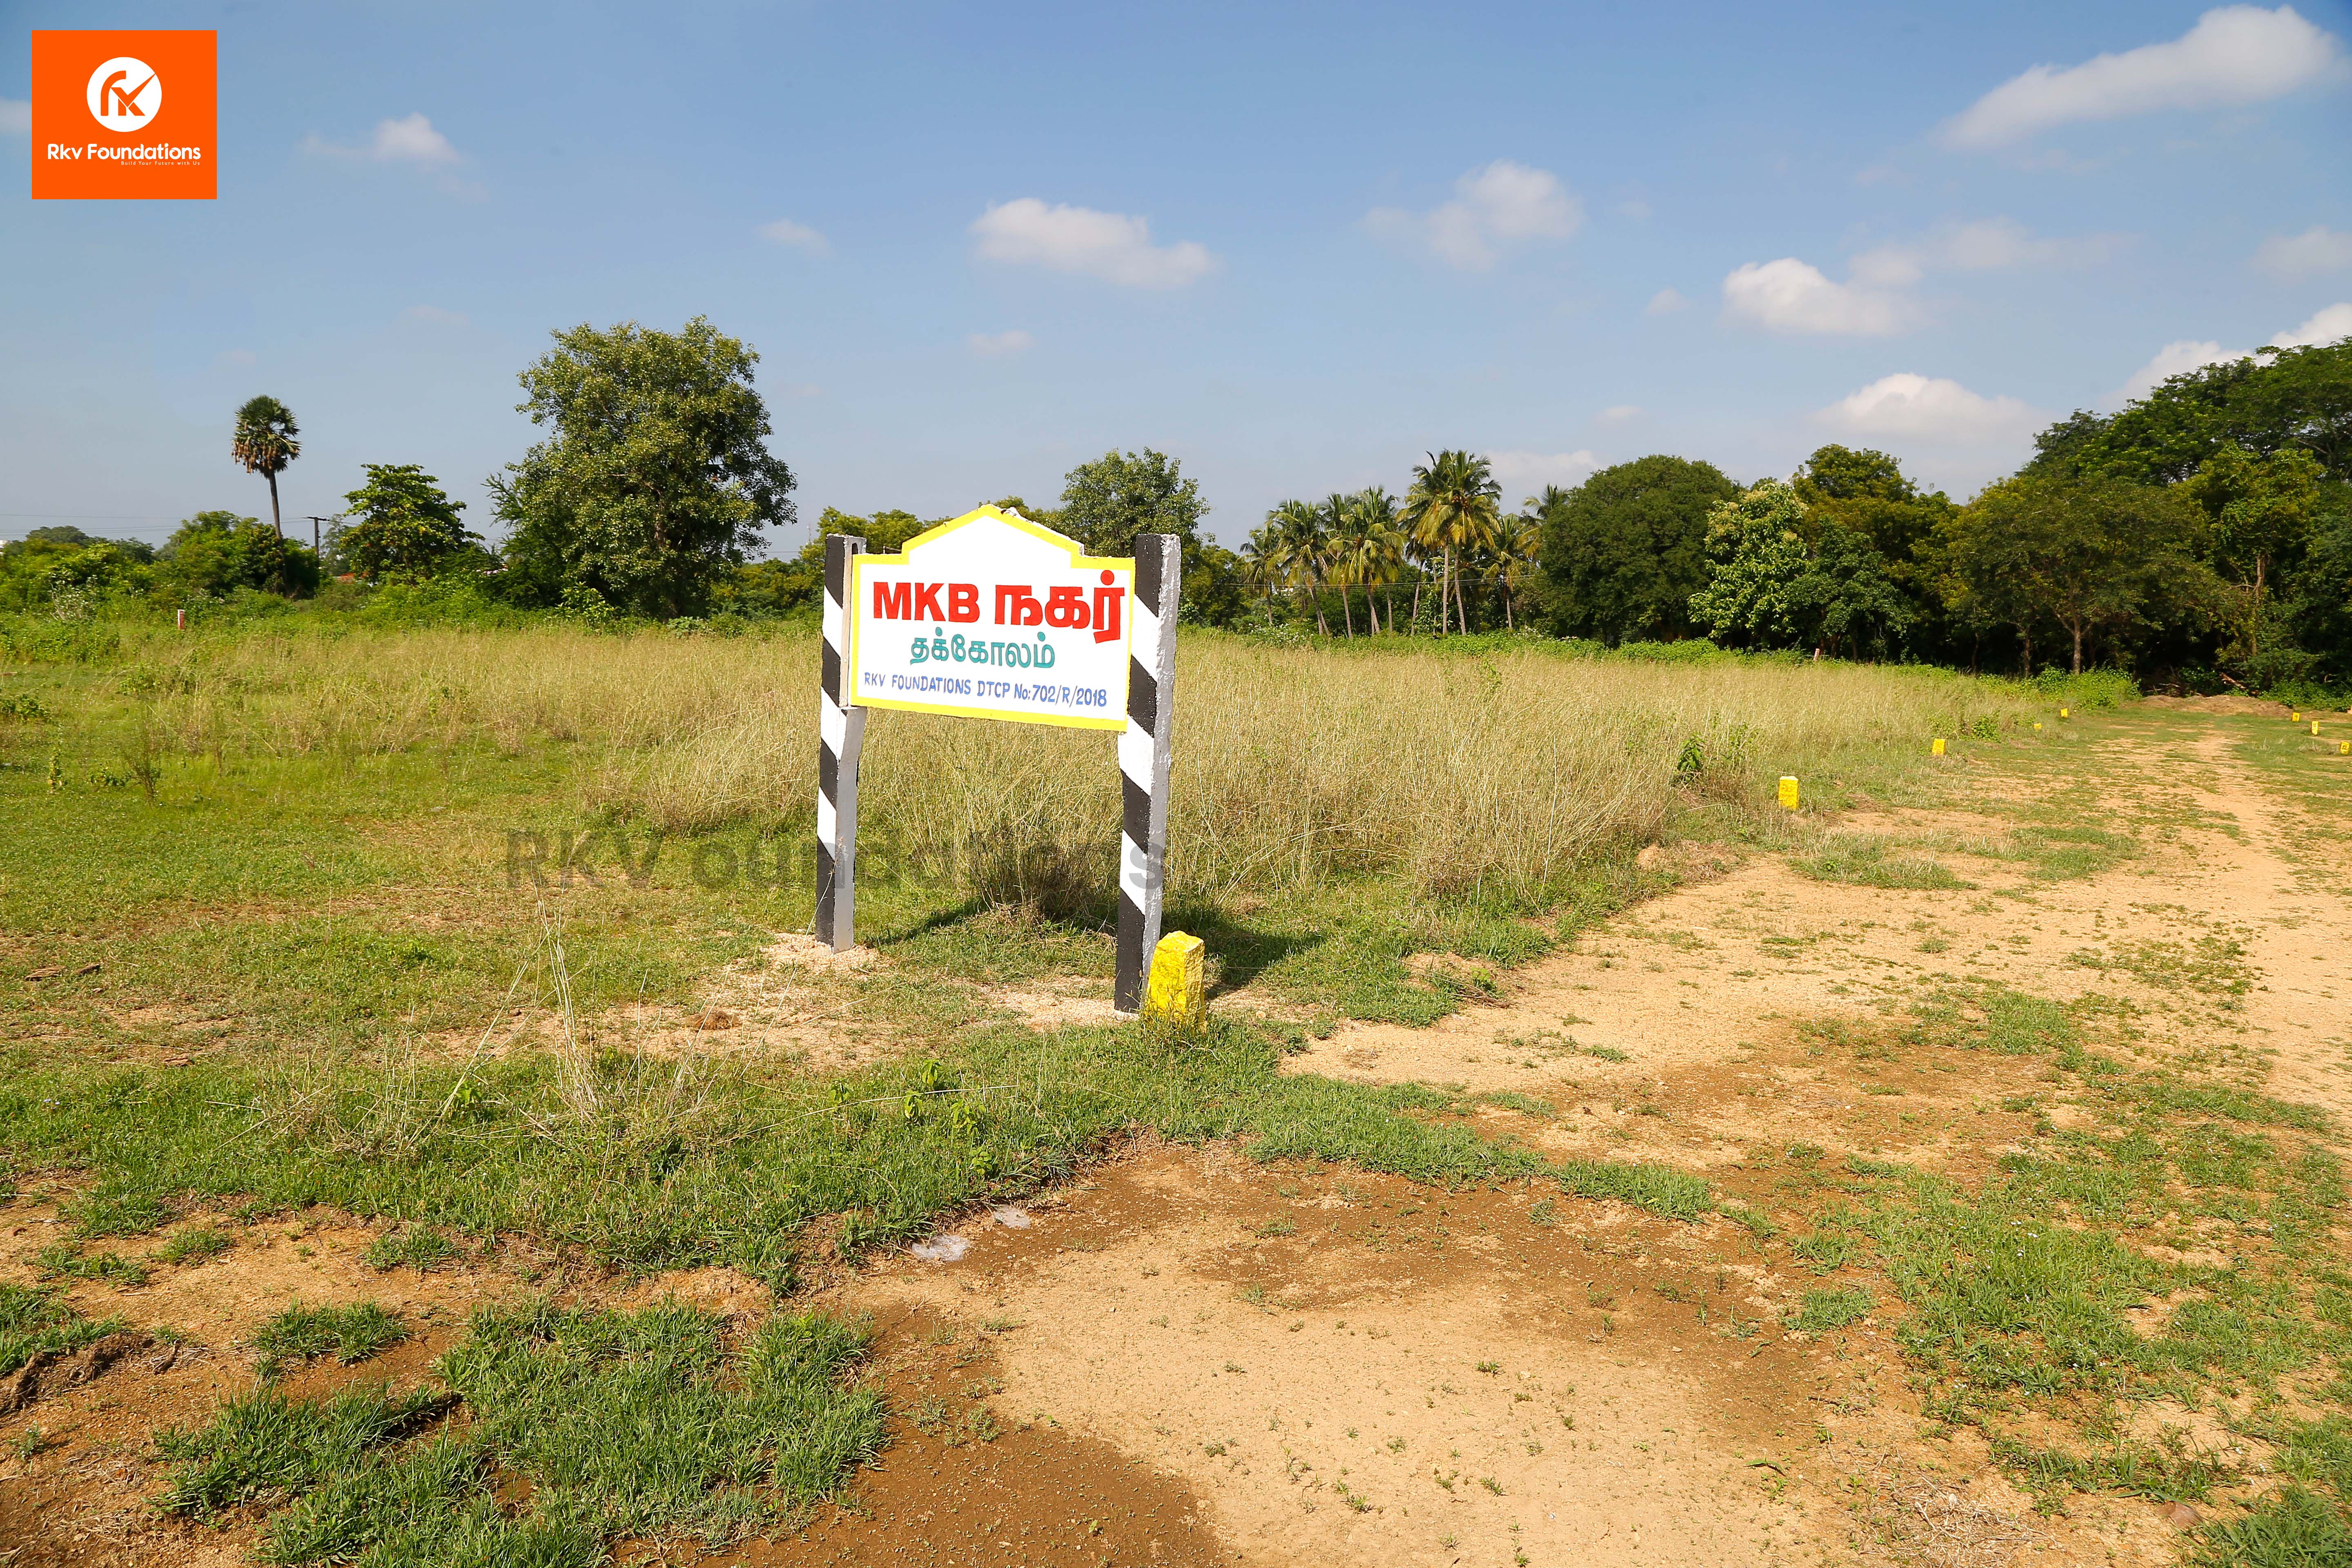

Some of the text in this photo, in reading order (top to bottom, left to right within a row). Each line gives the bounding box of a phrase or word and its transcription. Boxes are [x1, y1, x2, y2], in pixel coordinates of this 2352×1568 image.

[873, 570, 1125, 644] MKB நகர்
[910, 627, 1055, 668] தக்கோலம்
[864, 672, 886, 687] RKV
[892, 674, 971, 695] FOUNDATIONS
[977, 680, 1011, 699] DTCP
